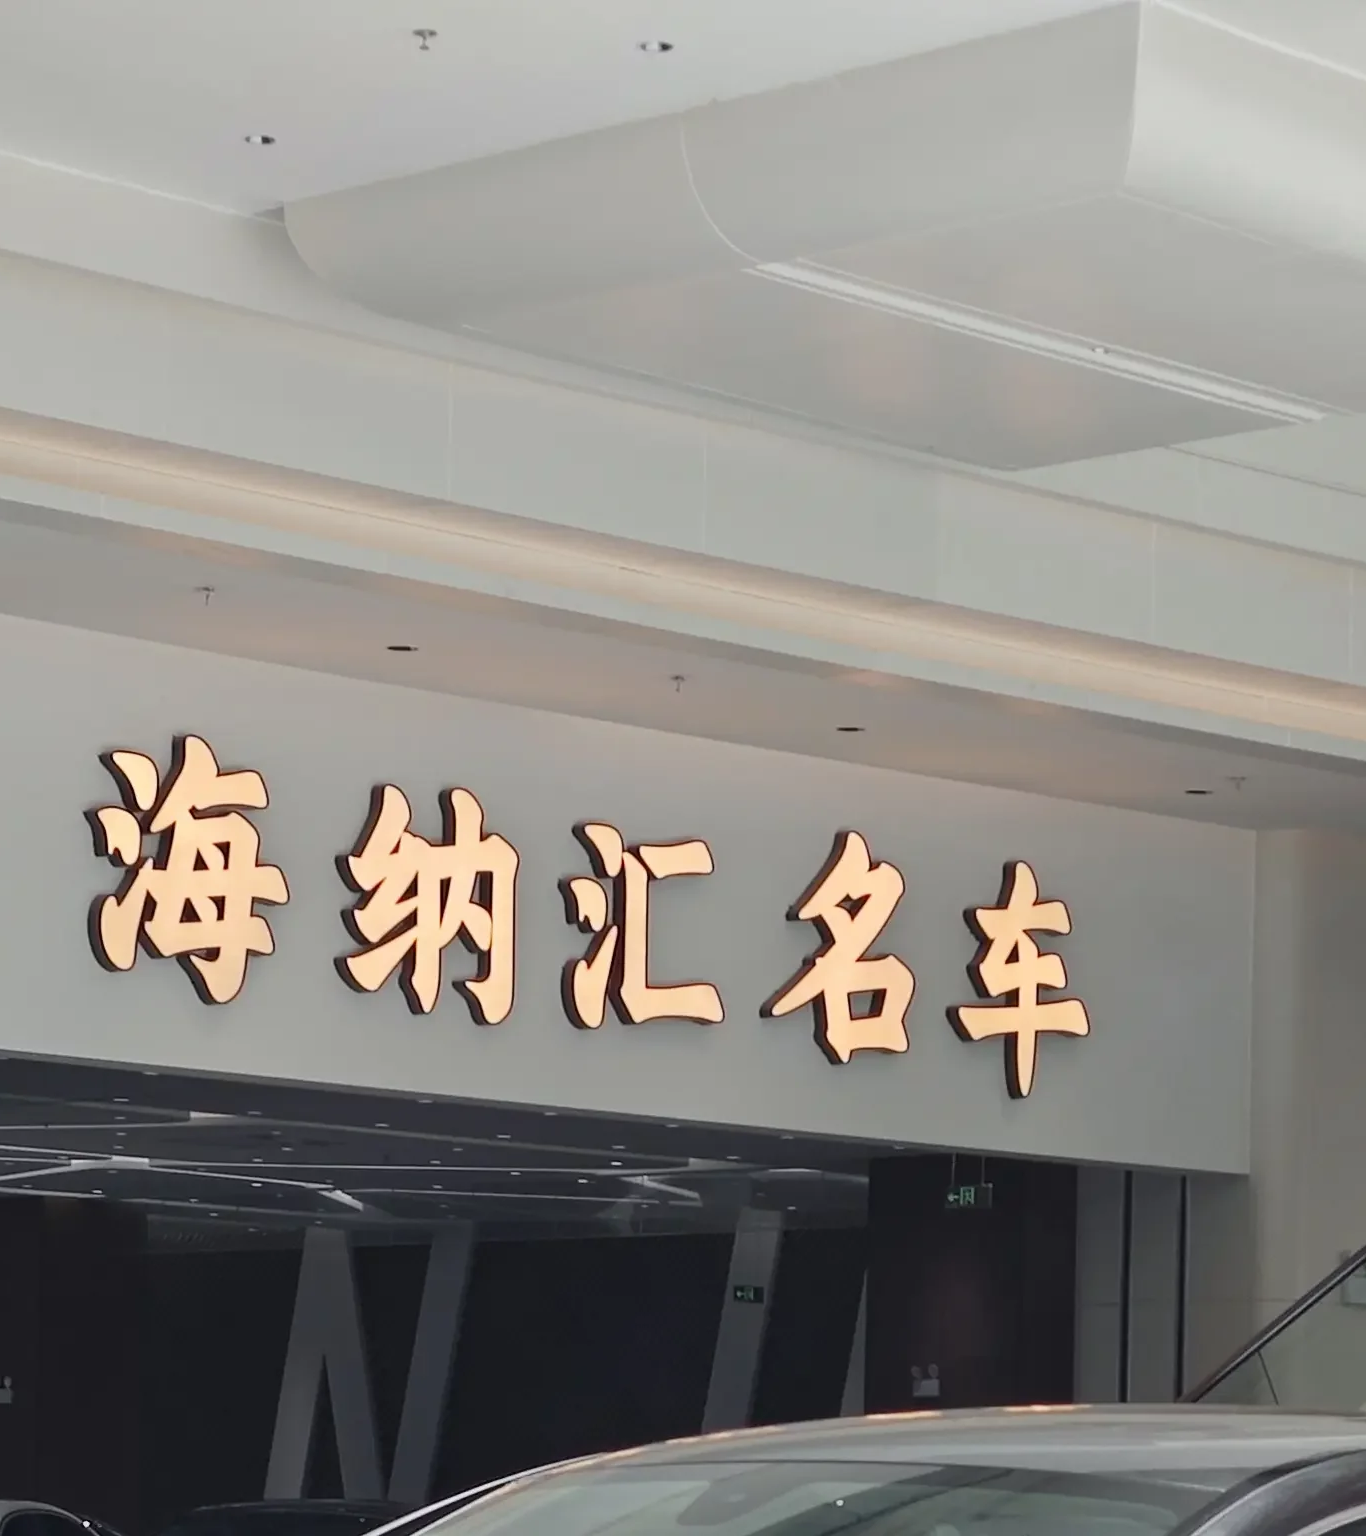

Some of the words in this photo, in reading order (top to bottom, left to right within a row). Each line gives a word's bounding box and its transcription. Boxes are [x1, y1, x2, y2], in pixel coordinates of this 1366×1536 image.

[85, 734, 1091, 1100] 海纳汇名车
